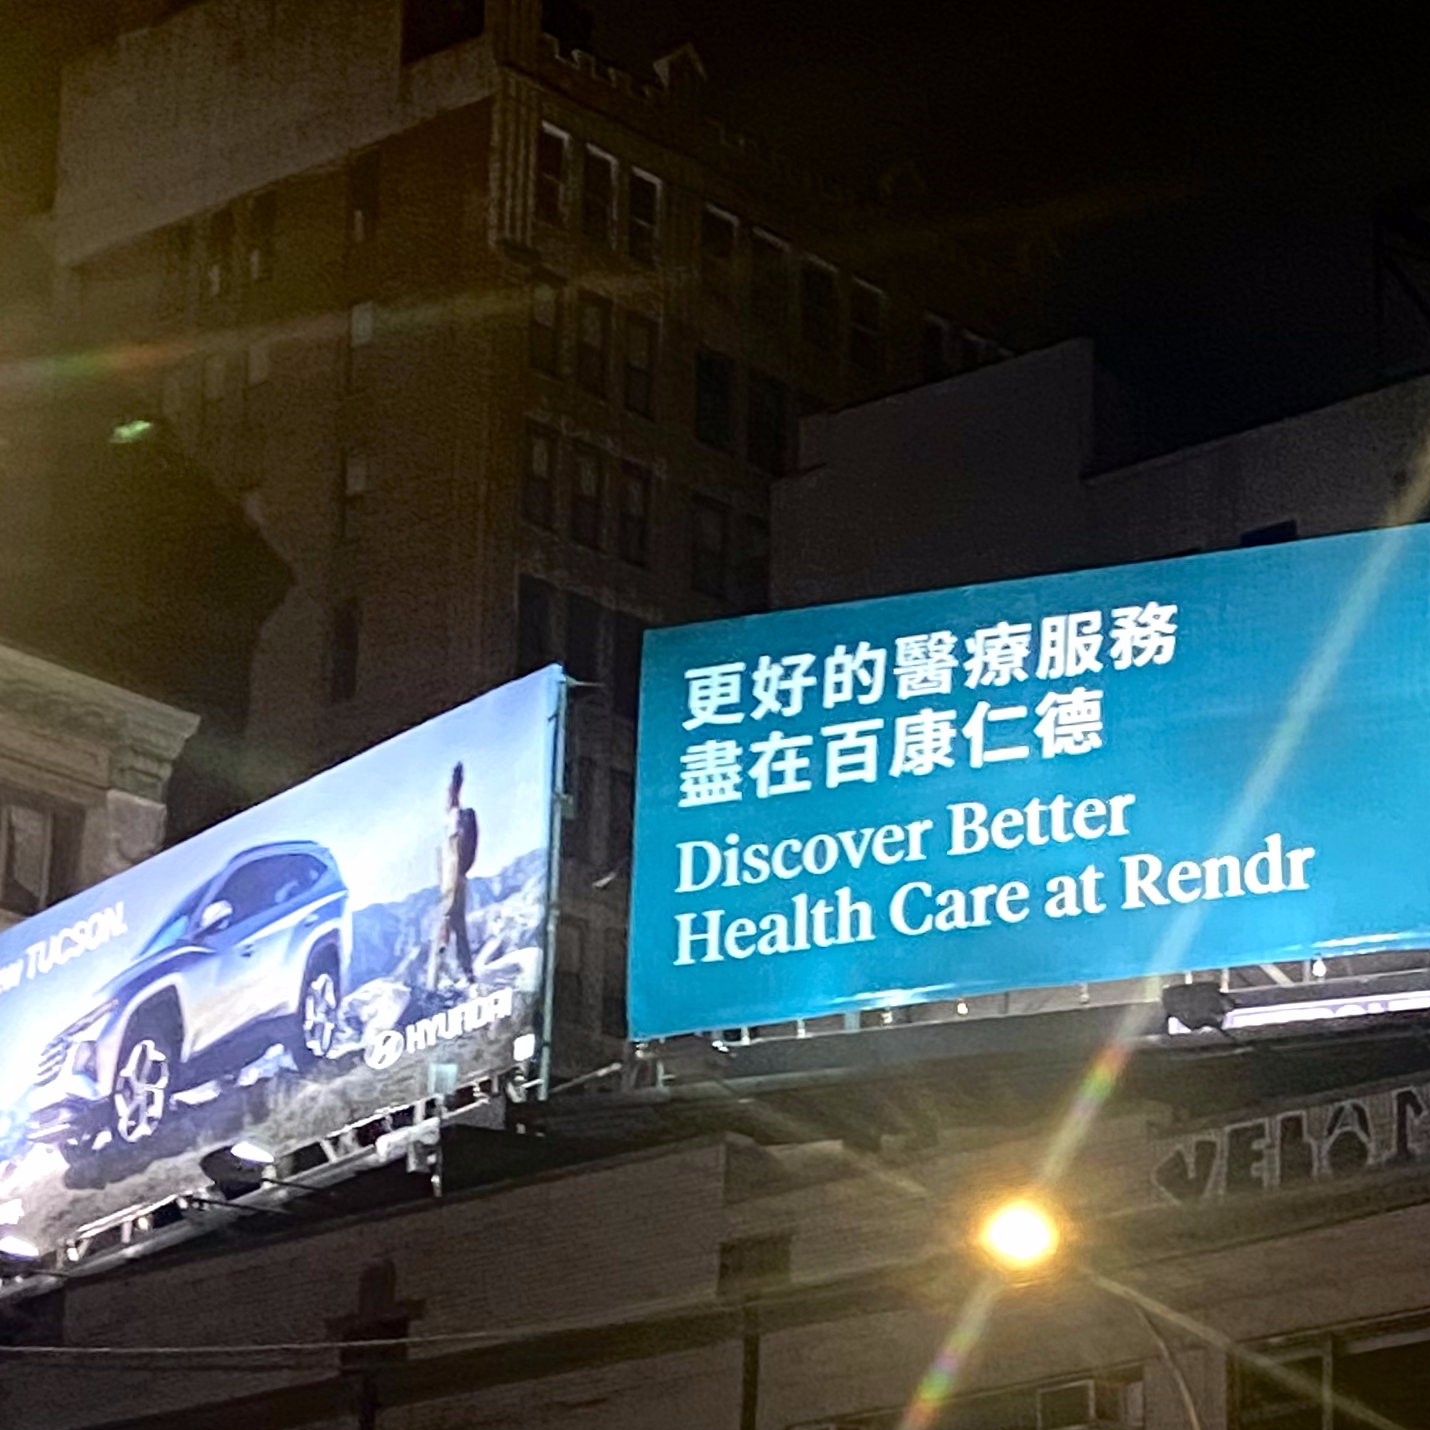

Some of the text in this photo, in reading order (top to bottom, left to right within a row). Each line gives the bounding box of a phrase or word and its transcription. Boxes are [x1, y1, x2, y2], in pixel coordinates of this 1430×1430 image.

[682, 602, 1178, 731] 更好的醫療服務
[679, 688, 1104, 809] 盡在百康仁德
[673, 833, 1315, 967] Health Care at Rendr
[675, 794, 1136, 893] Discover Better
[406, 986, 513, 1054] HYUNDAI
